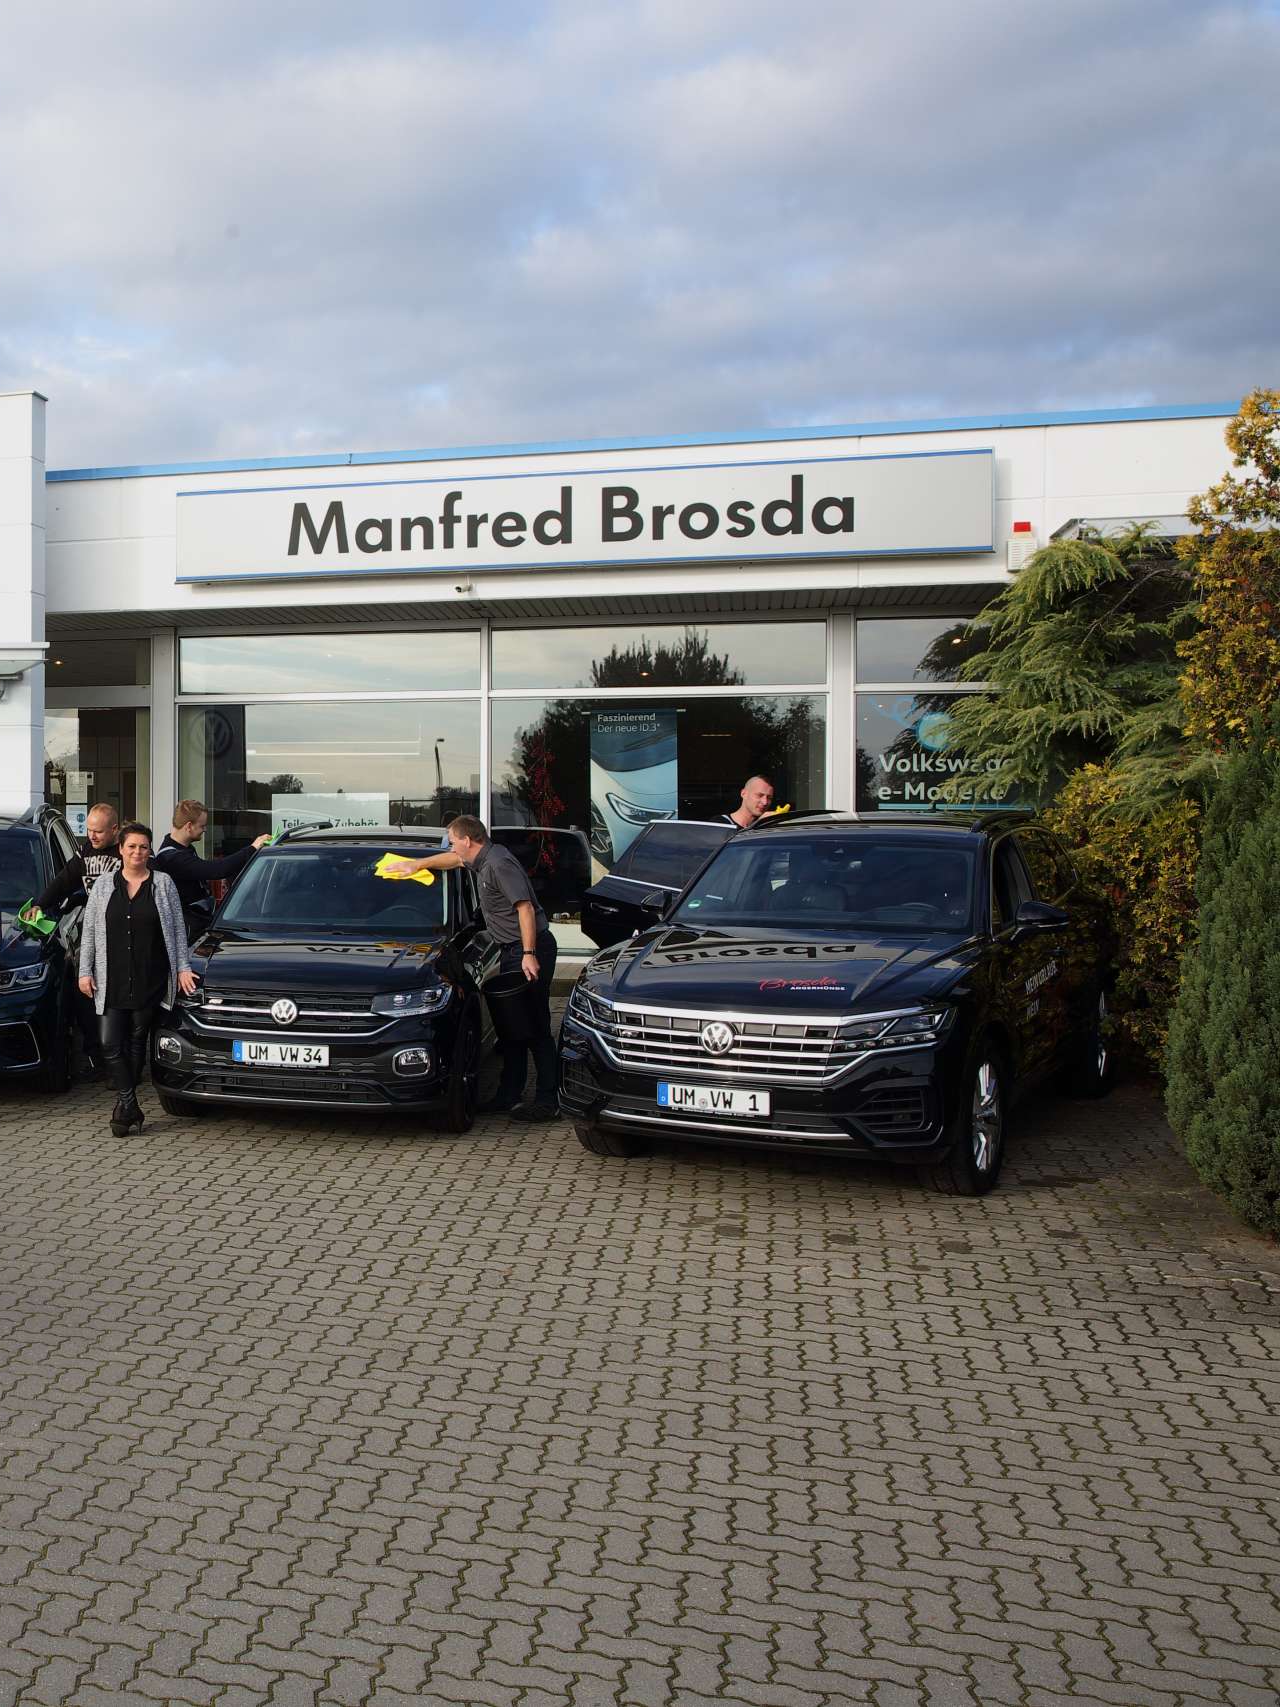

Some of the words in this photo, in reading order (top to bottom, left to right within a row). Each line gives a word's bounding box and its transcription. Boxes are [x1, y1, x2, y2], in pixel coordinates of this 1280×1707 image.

[287, 485, 573, 556] Manfred
[601, 473, 855, 542] Brosda
[597, 713, 656, 722] Faszinierend
[597, 724, 613, 733] Der
[248, 1045, 268, 1060] UM
[279, 1047, 299, 1062] VW
[303, 1048, 322, 1063] 34
[672, 1087, 695, 1105] UM
[710, 1090, 733, 1109] VW
[748, 1094, 759, 1112] 1
